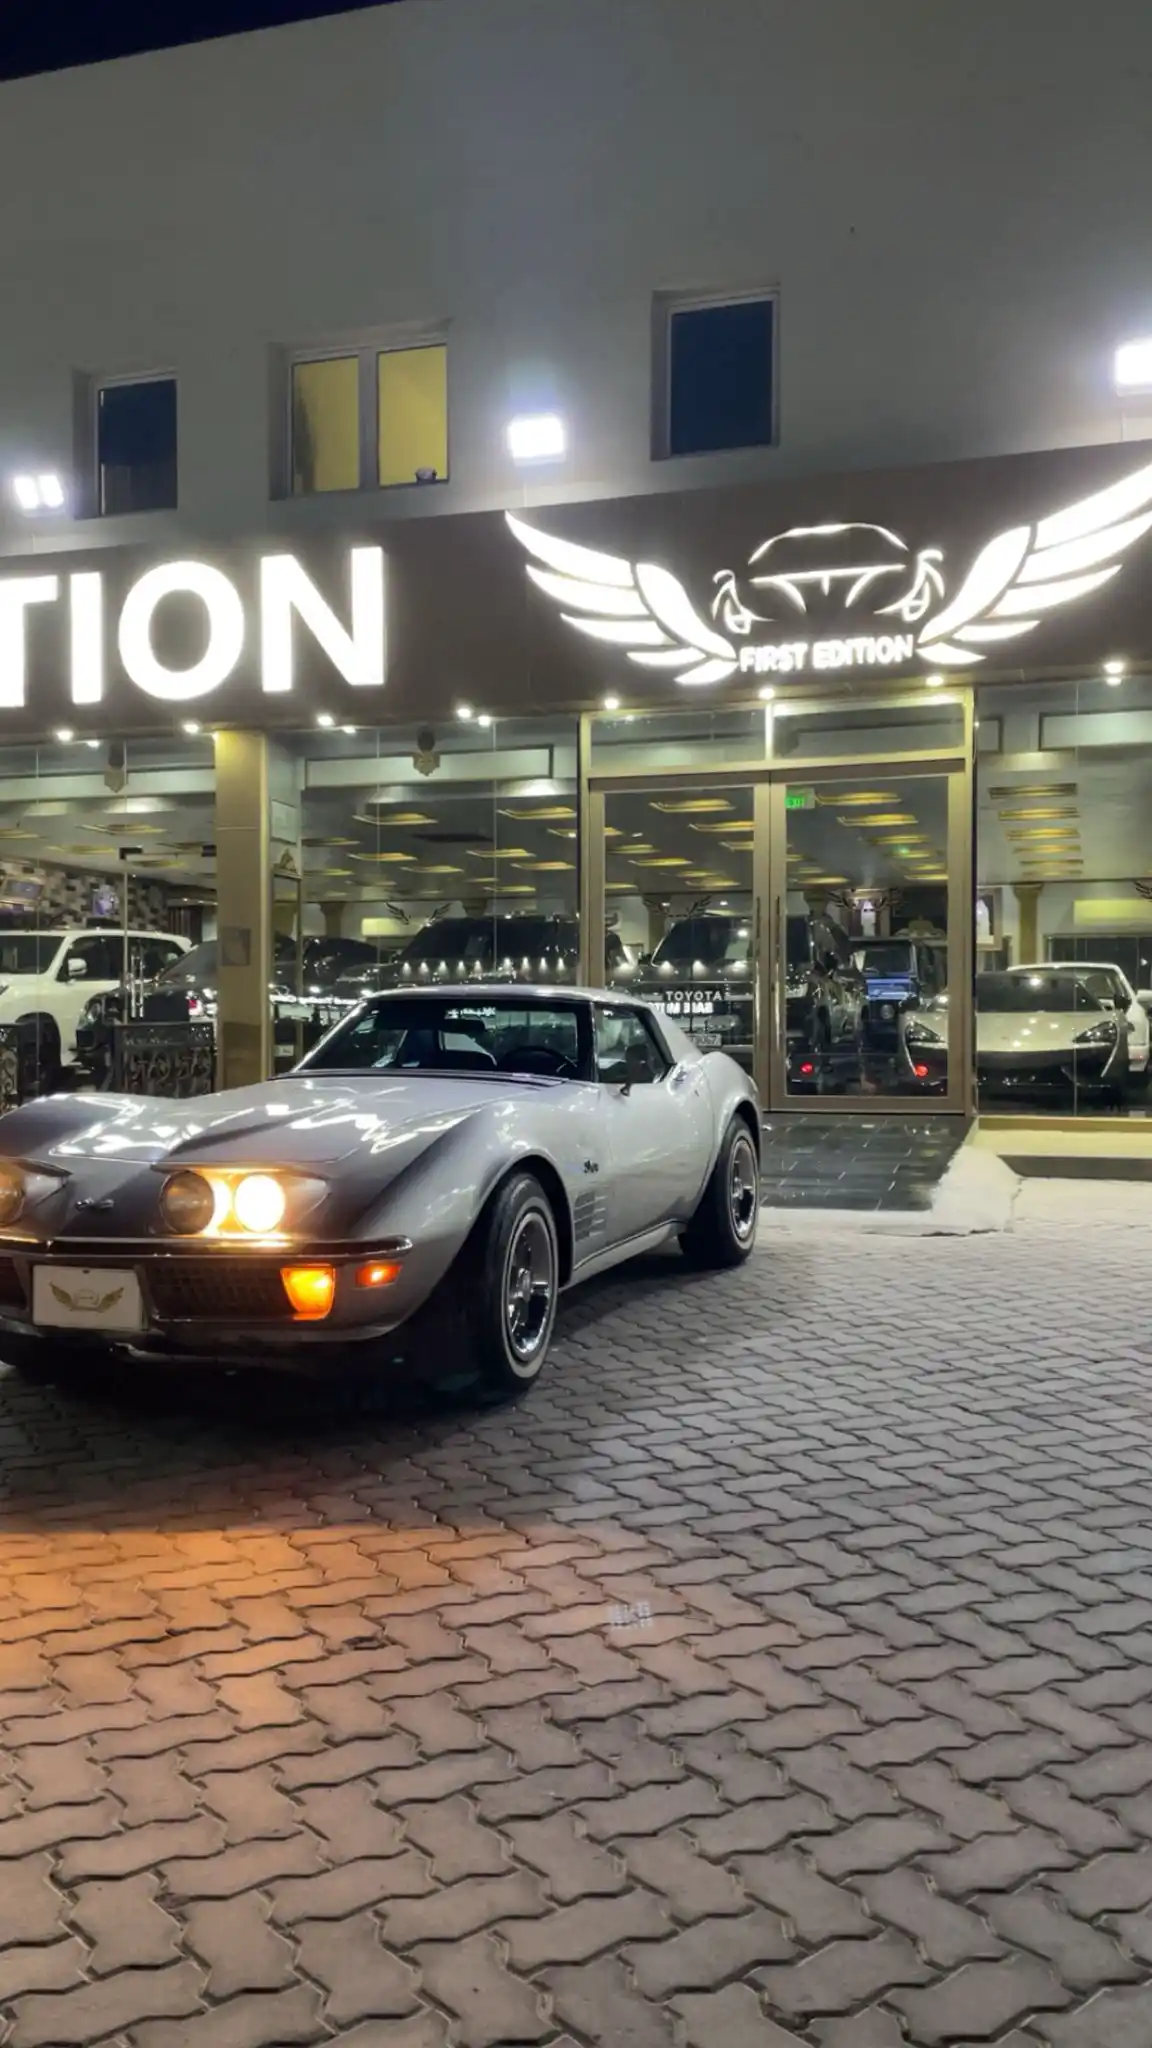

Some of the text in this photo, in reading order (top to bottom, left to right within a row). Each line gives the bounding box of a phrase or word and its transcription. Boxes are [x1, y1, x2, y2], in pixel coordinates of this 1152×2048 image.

[739, 634, 914, 673] FIRST EDITION
[665, 990, 723, 1001] TOYOTA
